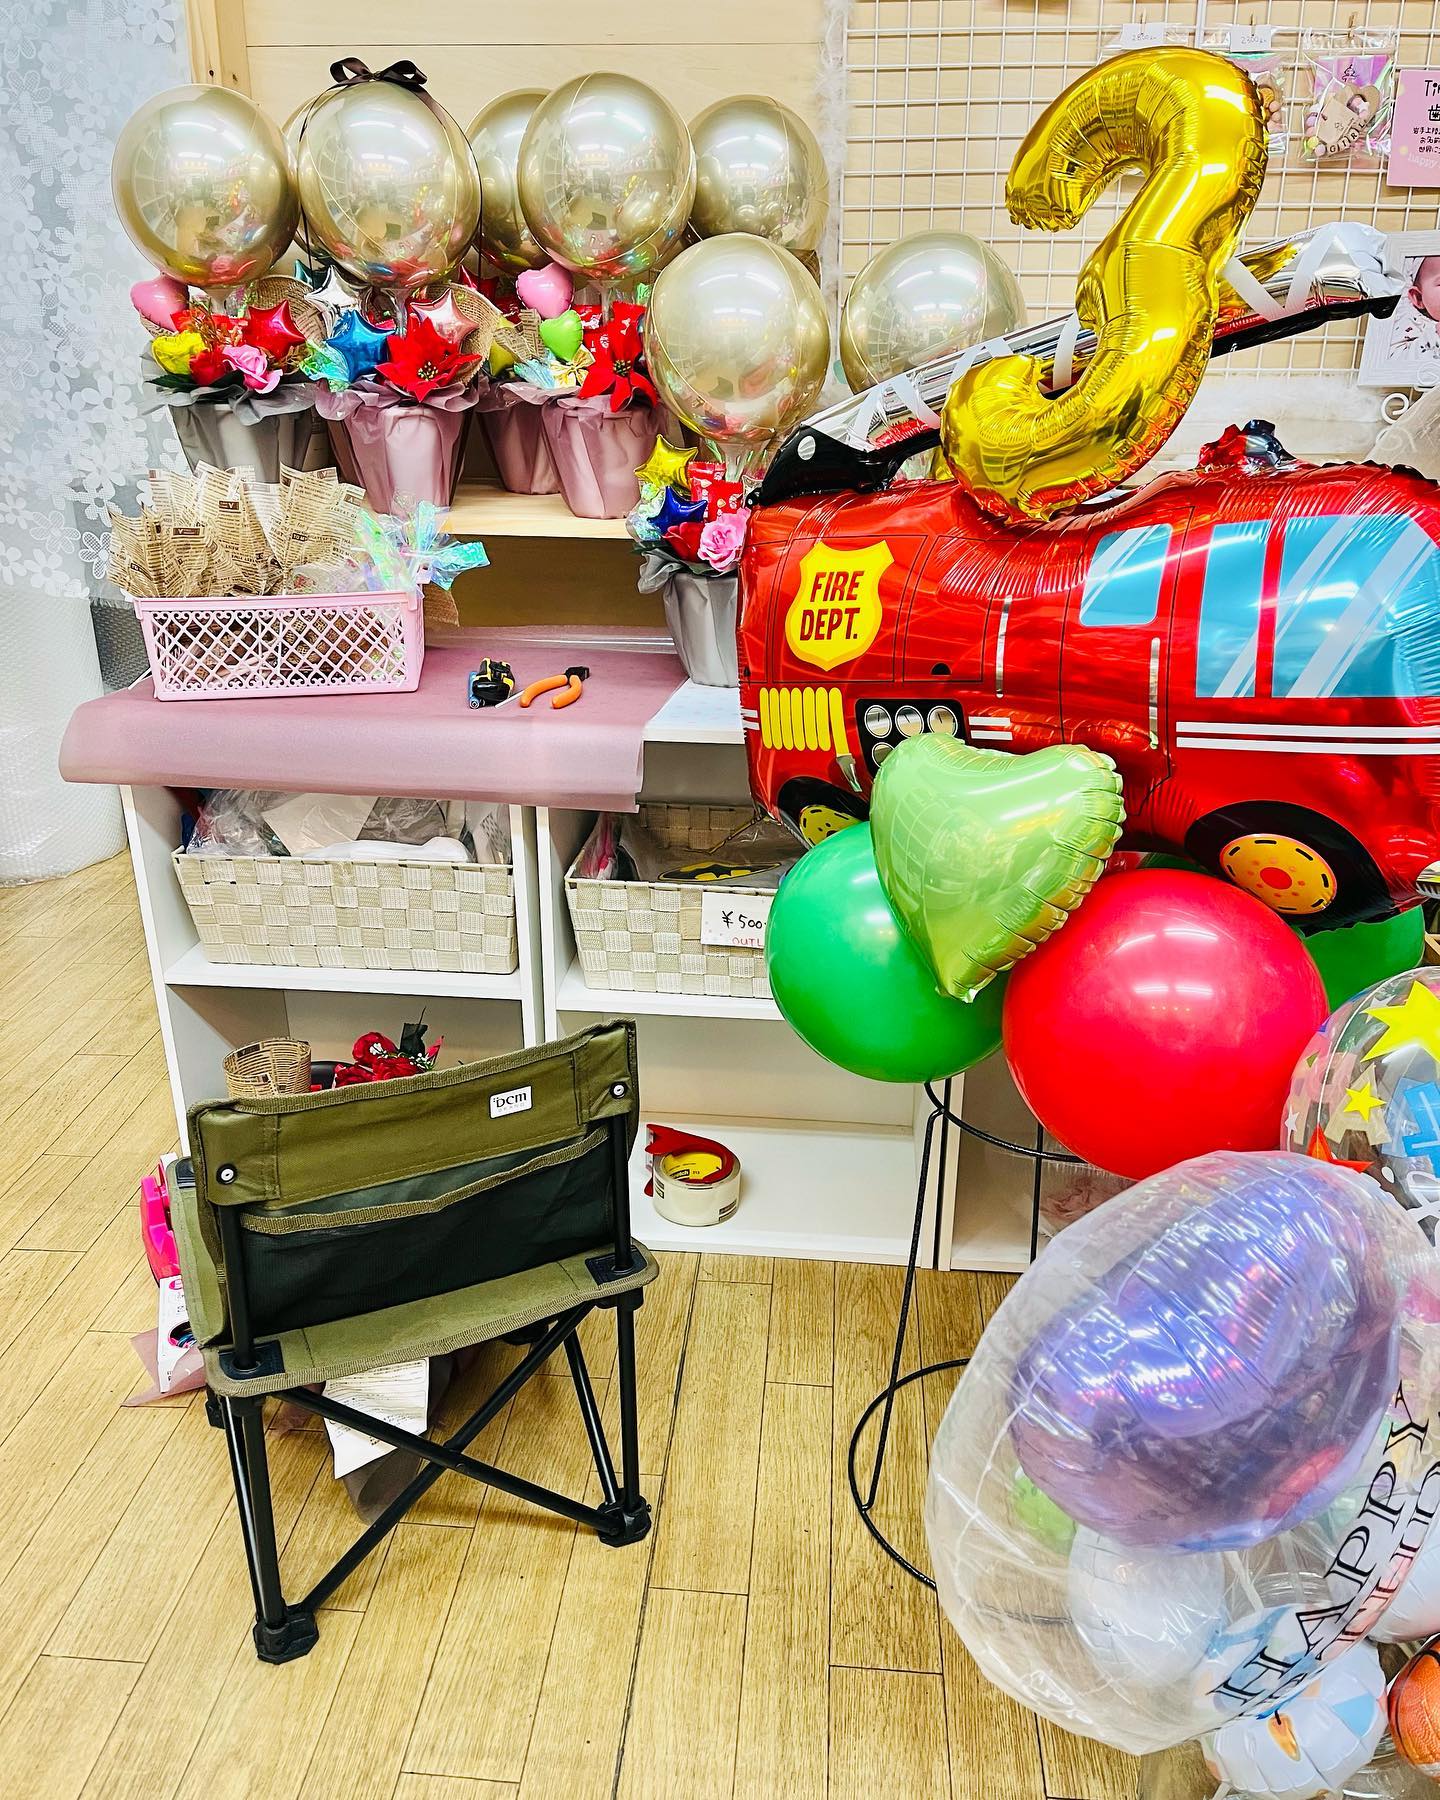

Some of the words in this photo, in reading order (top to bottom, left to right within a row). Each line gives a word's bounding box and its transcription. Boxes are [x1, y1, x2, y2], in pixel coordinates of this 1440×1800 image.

[1328, 119, 1368, 153] GIRL
[809, 571, 865, 602] FIRE
[799, 607, 861, 641] DEPT.
[731, 936, 765, 948] OUTL
[1205, 1378, 1430, 1706] HAPPY
